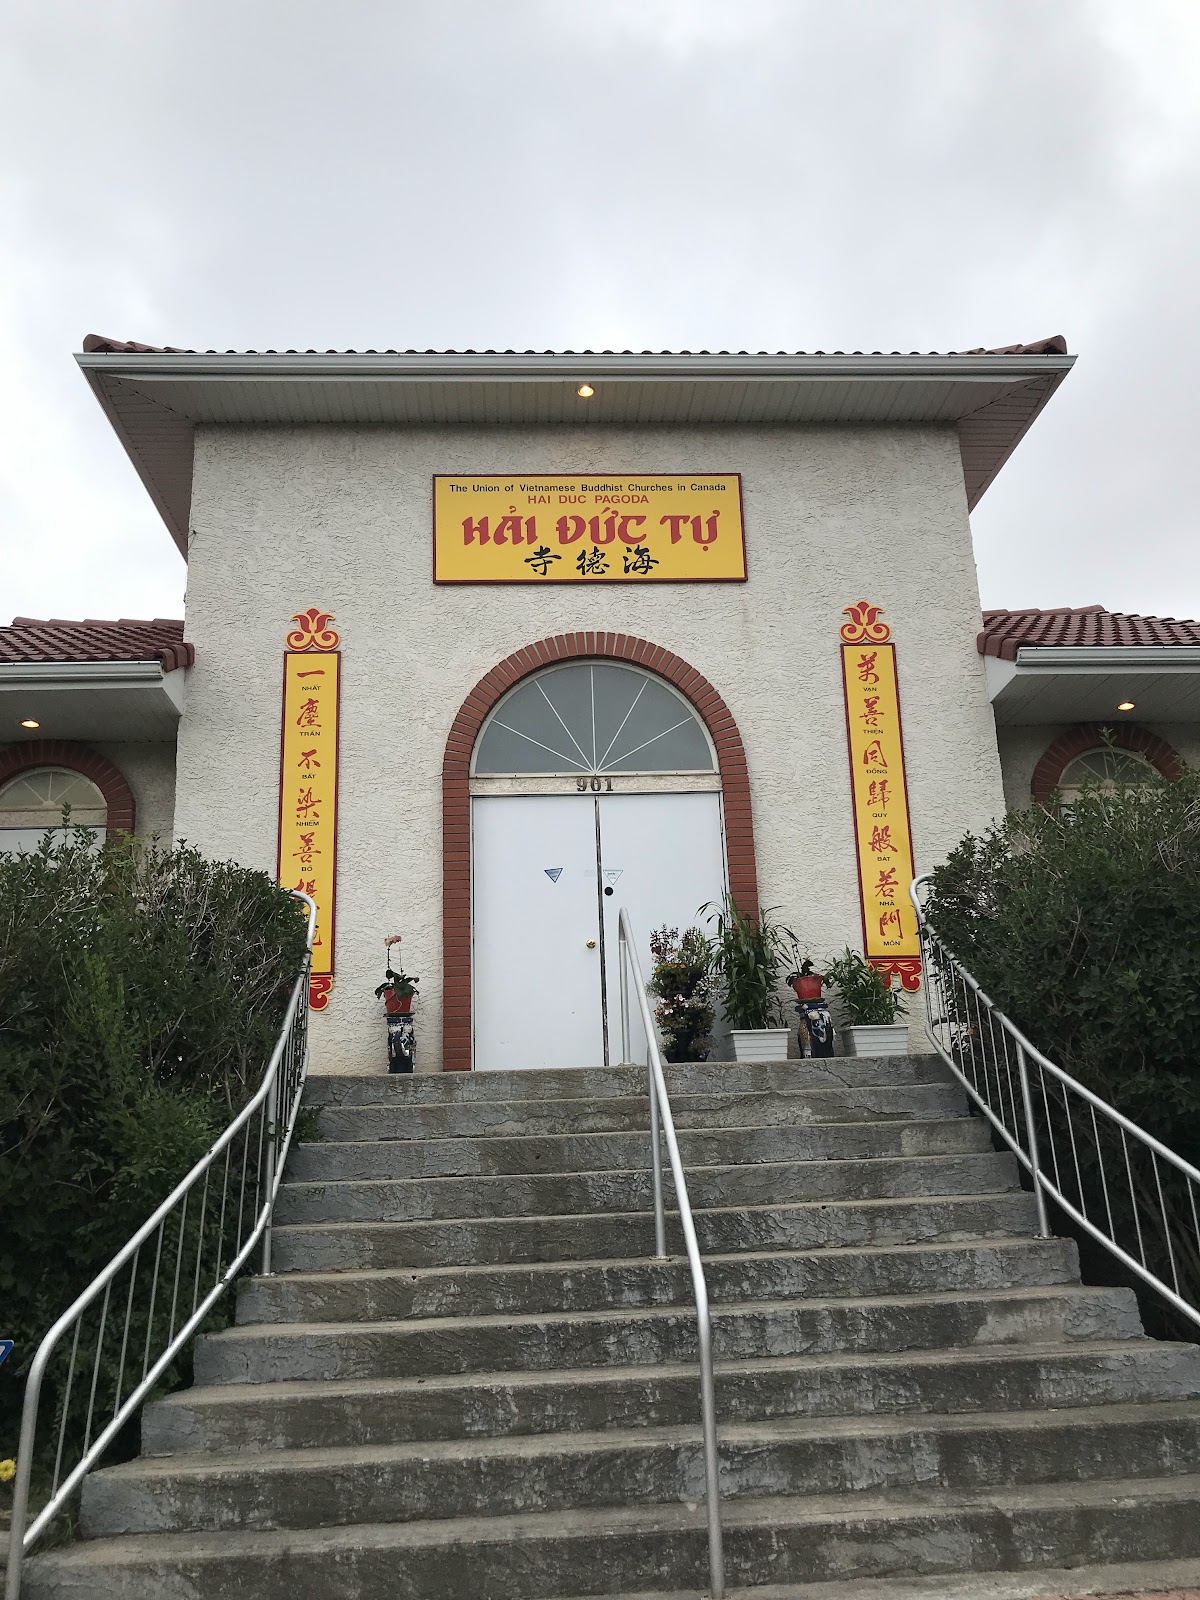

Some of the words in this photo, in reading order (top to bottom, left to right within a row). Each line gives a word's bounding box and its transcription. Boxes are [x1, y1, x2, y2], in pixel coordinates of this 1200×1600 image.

[449, 484, 468, 492] The
[472, 484, 500, 492] Union
[504, 484, 514, 492] of
[519, 484, 576, 492] Vietnamese
[581, 484, 623, 492] Buddhist
[628, 483, 673, 492] Churches
[677, 483, 686, 491] in
[690, 483, 726, 491] Canada
[527, 495, 551, 504] HAI
[558, 495, 587, 504] DUC
[594, 494, 650, 504] PAGODA
[461, 505, 538, 546] HẢI
[555, 506, 647, 545] ĐỨC
[659, 509, 720, 552] TỰ
[576, 777, 614, 792] 901
